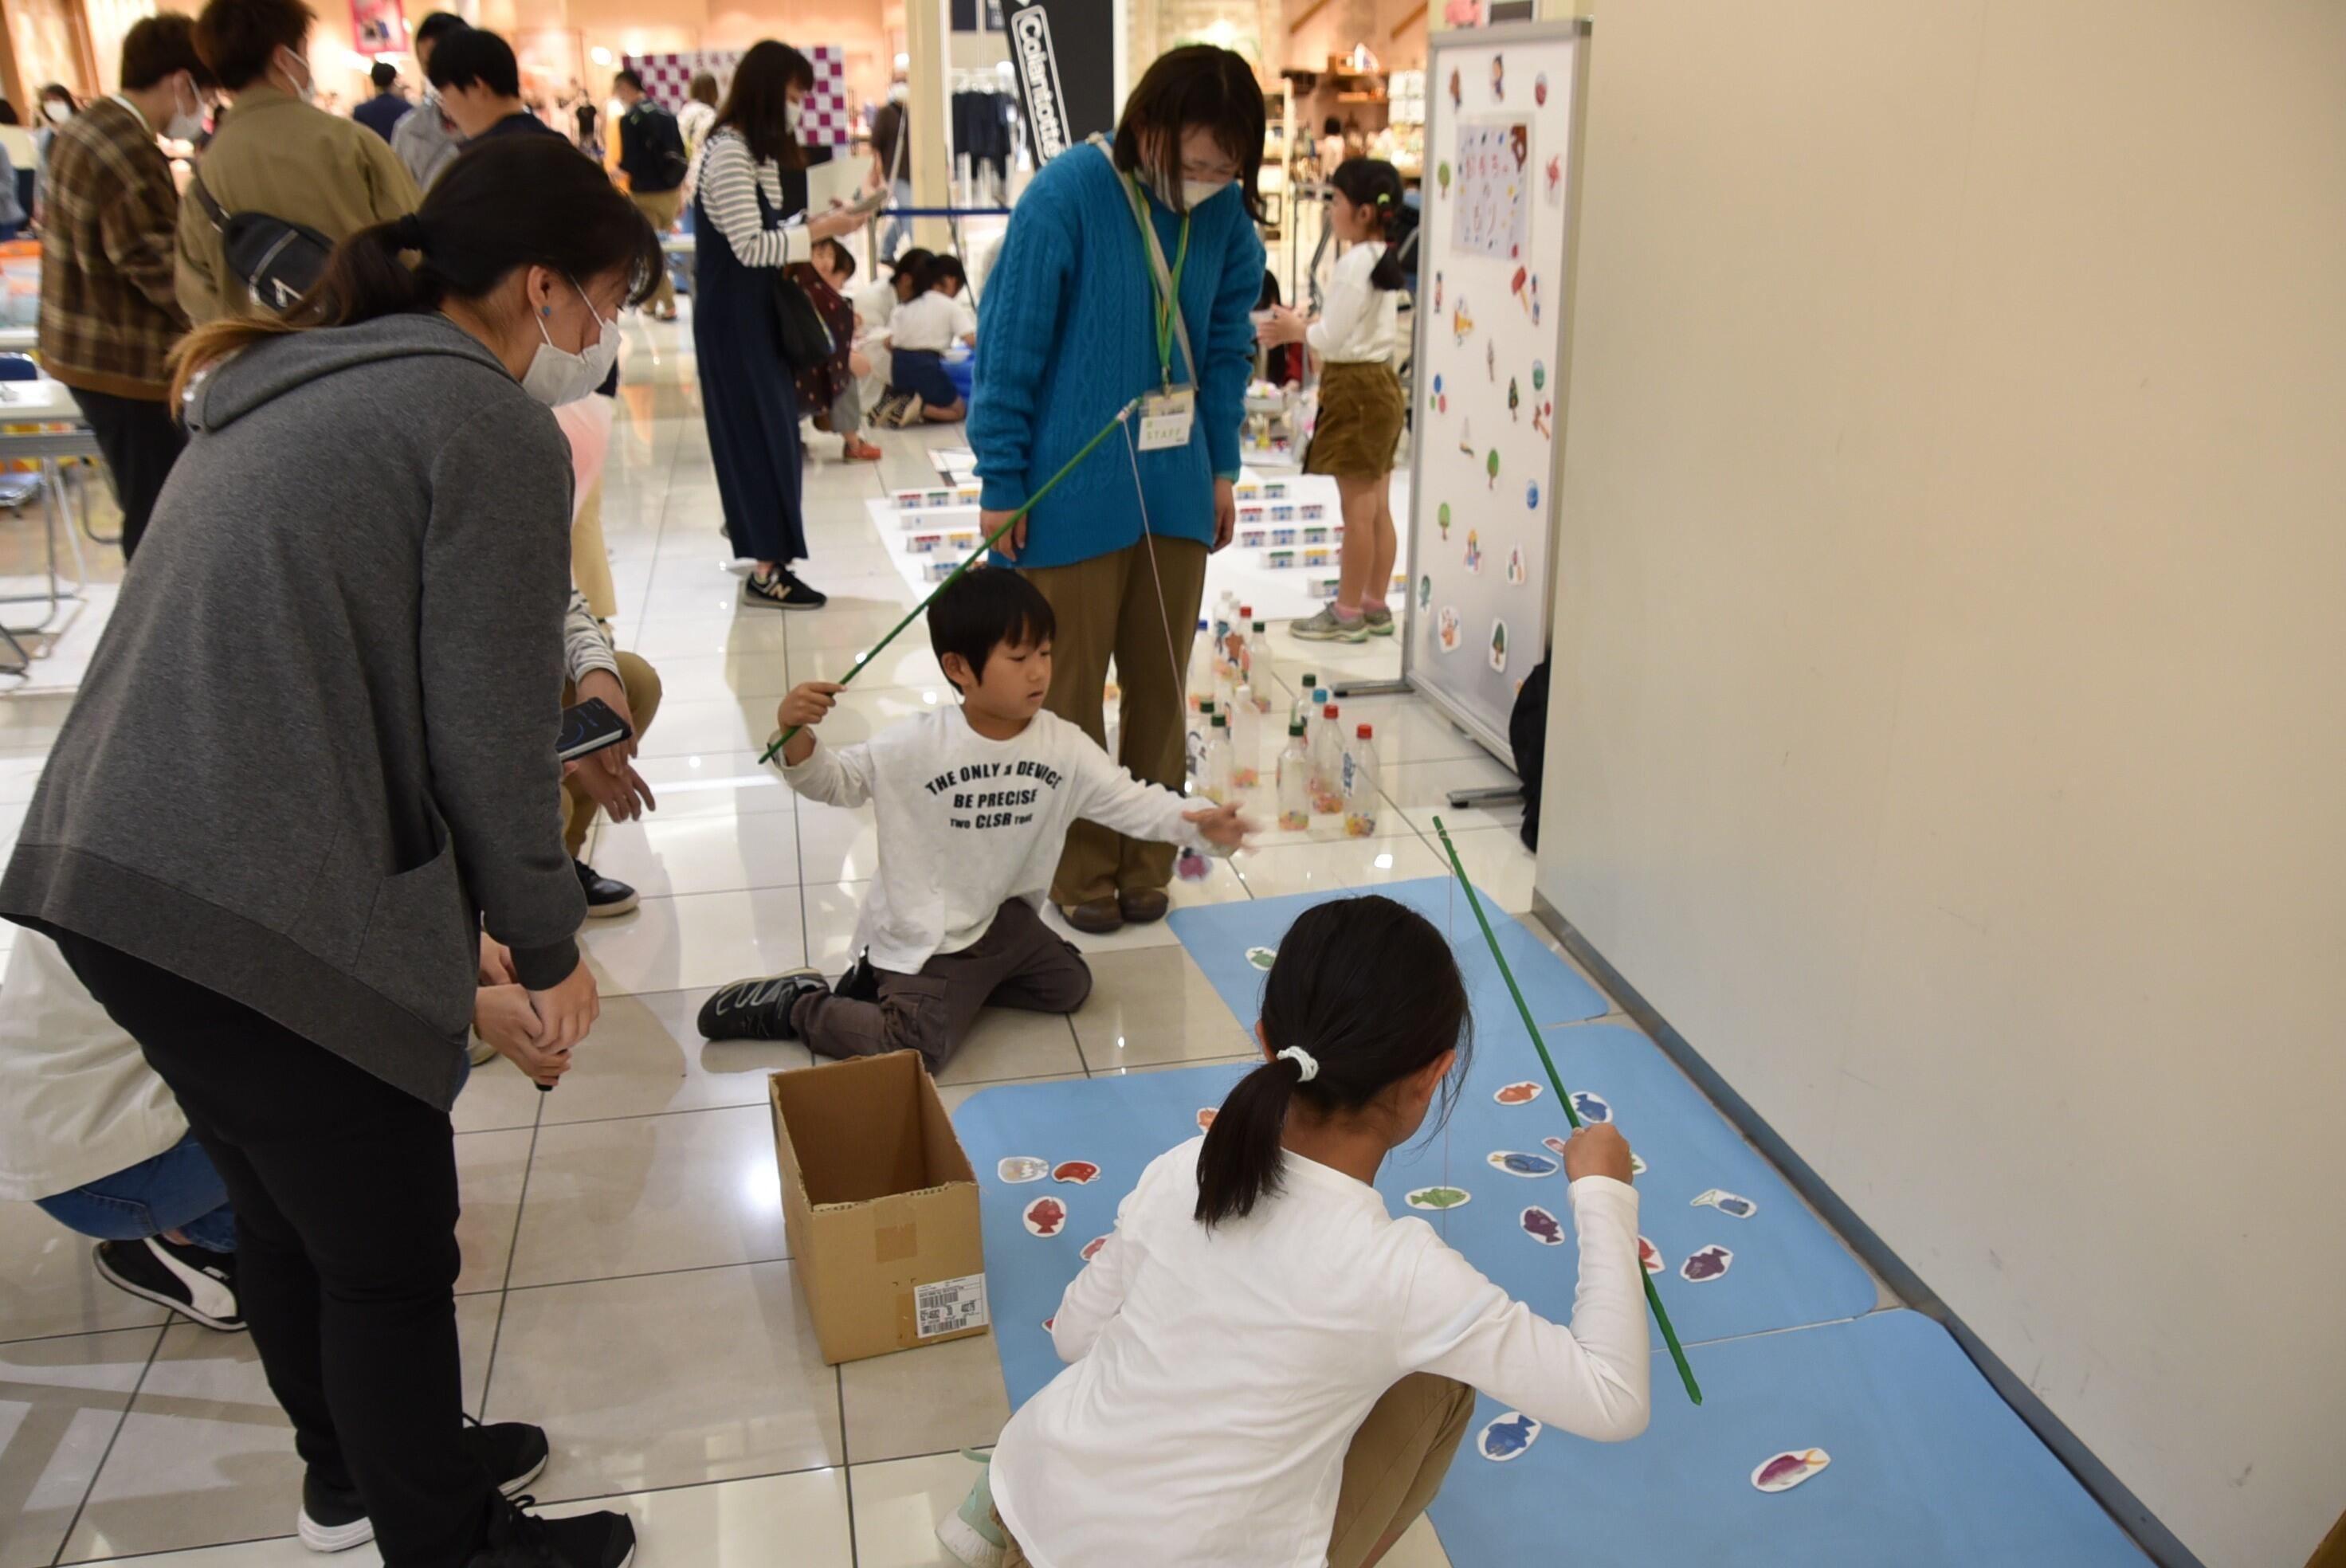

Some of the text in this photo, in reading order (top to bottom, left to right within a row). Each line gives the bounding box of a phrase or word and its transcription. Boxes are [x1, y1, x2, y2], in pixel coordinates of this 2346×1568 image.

[925, 770, 957, 796] THE
[959, 762, 1000, 782] ONLY
[953, 789, 1038, 809] BE PRECISE
[950, 817, 971, 829] TWO
[975, 812, 1012, 829] CLSR
